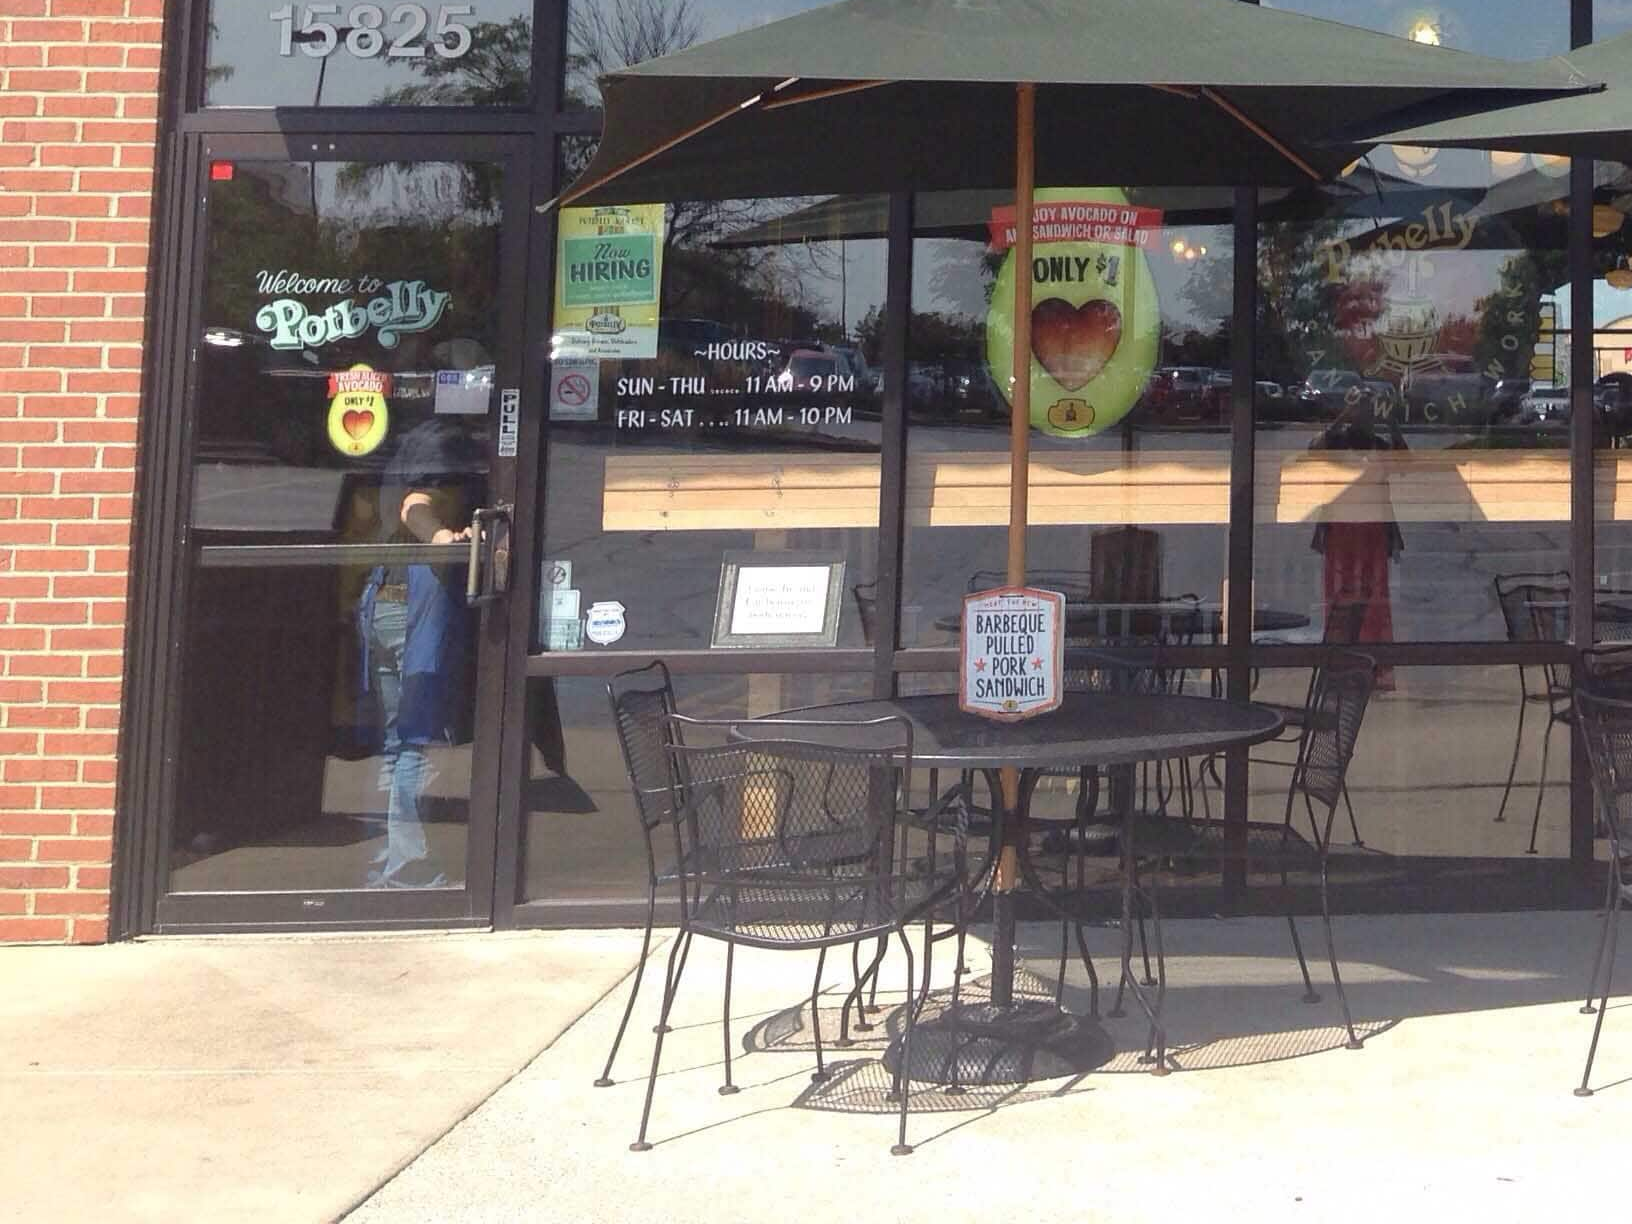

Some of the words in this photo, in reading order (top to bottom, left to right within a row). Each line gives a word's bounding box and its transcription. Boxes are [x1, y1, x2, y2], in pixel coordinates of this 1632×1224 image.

[270, 3, 475, 59] 15825
[1033, 208, 1057, 223] JOY
[1061, 207, 1117, 223] AVOCADO
[1120, 210, 1138, 225] ON
[1032, 225, 1091, 241] SANDWICH
[1094, 226, 1112, 241] OR
[1114, 229, 1149, 245] SALAD
[594, 242, 632, 260] Now
[570, 259, 651, 282] HIRING
[1032, 257, 1090, 284] ONLY
[1096, 252, 1121, 287] $1
[256, 270, 353, 294] Welcome
[358, 275, 384, 294] to
[256, 280, 450, 350] Potbelly
[338, 380, 384, 393] AVOCADO
[617, 377, 654, 396] SUN
[669, 377, 705, 395] THU
[745, 376, 760, 394] 11
[764, 376, 793, 393] AM
[809, 375, 822, 393] 9
[827, 375, 854, 393] PM
[344, 396, 364, 407] ONLY
[502, 394, 517, 434] PULL
[618, 410, 645, 429] FRI
[660, 409, 694, 428] SAT
[735, 408, 750, 426] 11
[754, 407, 783, 426] AM
[799, 407, 820, 425] 10
[824, 406, 852, 425] PM
[976, 614, 1046, 635] BARBEQUE
[986, 635, 1034, 655] PULLED
[992, 656, 1027, 677] PORK
[975, 677, 1045, 698] SANDWICH
